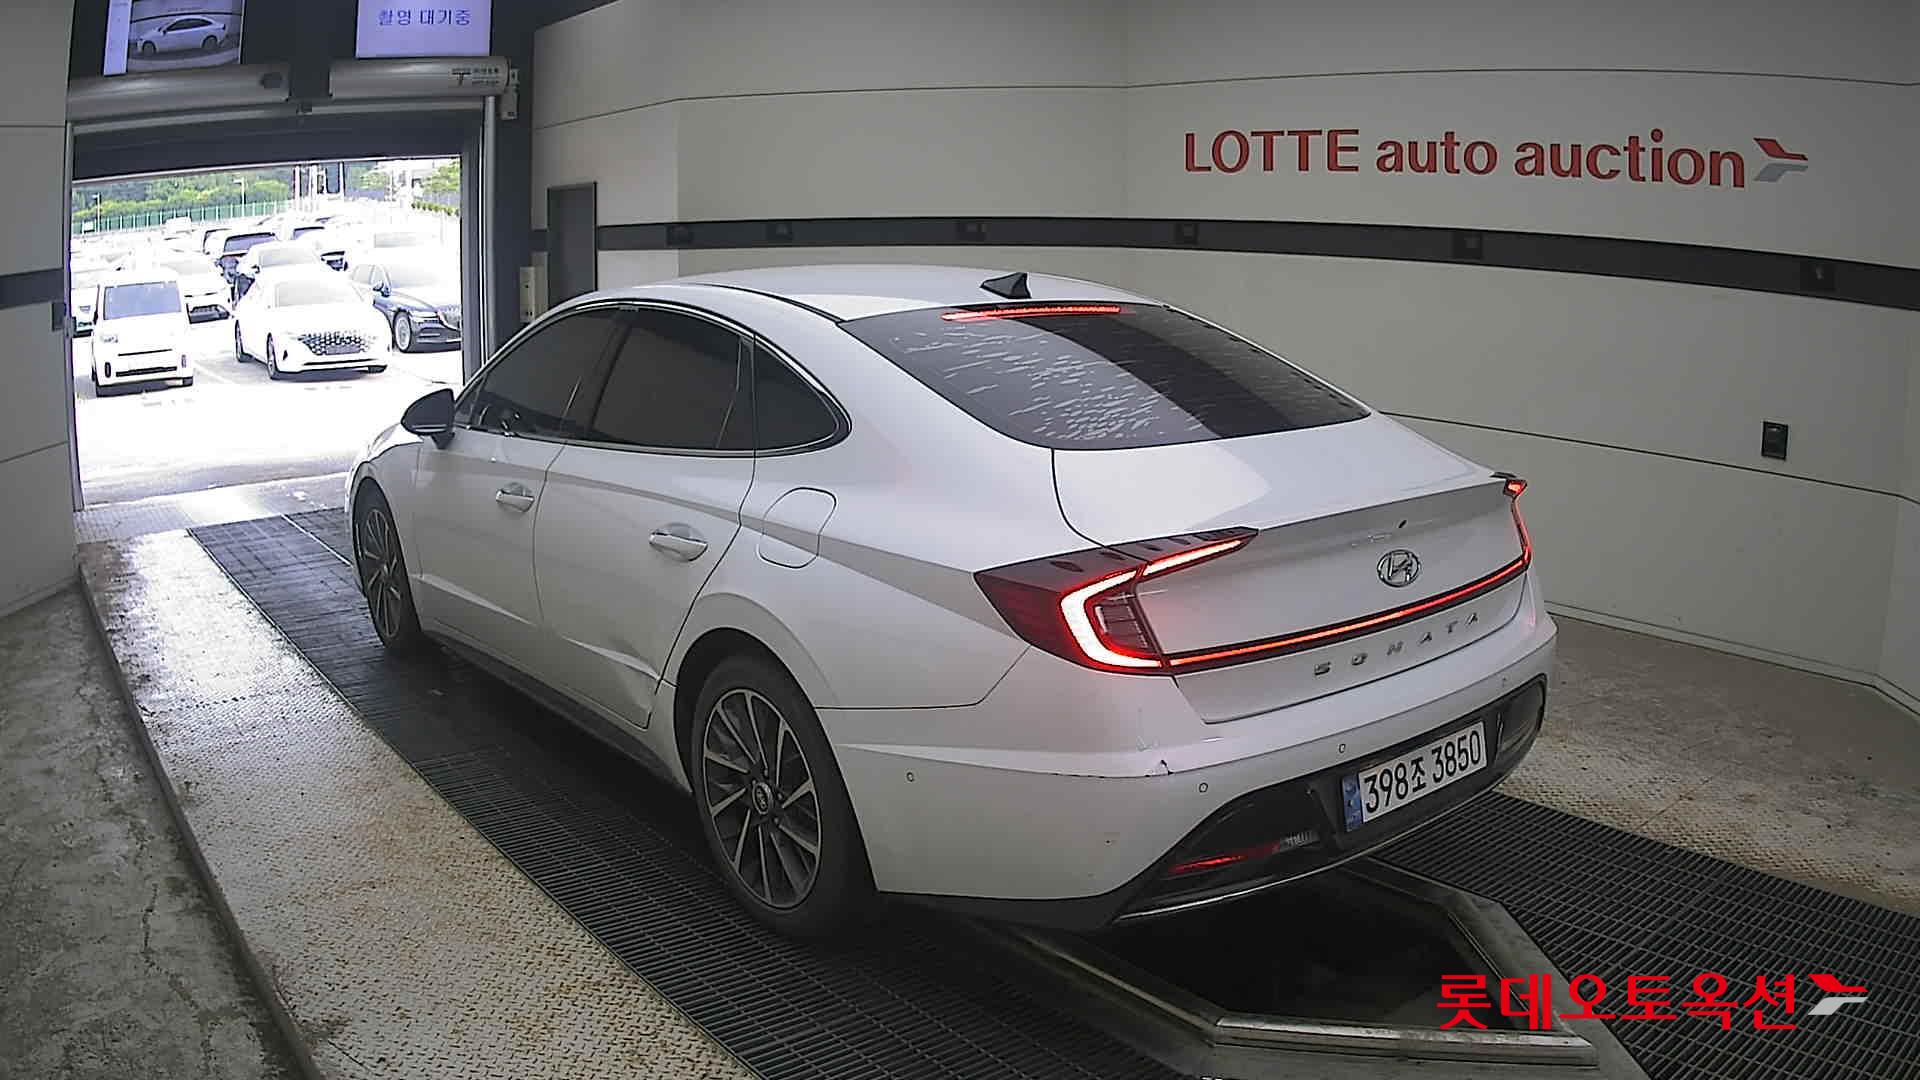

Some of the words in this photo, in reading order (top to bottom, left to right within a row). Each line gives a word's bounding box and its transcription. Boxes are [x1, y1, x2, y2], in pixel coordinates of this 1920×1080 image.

[419, 9, 472, 26] 대기중
[1185, 129, 1360, 173] LOTTE
[1376, 131, 1498, 175] auto
[1514, 128, 1745, 188] auction
[1313, 612, 1479, 676] SONATA
[1364, 757, 1426, 813] 398조
[1432, 730, 1481, 783] 3850
